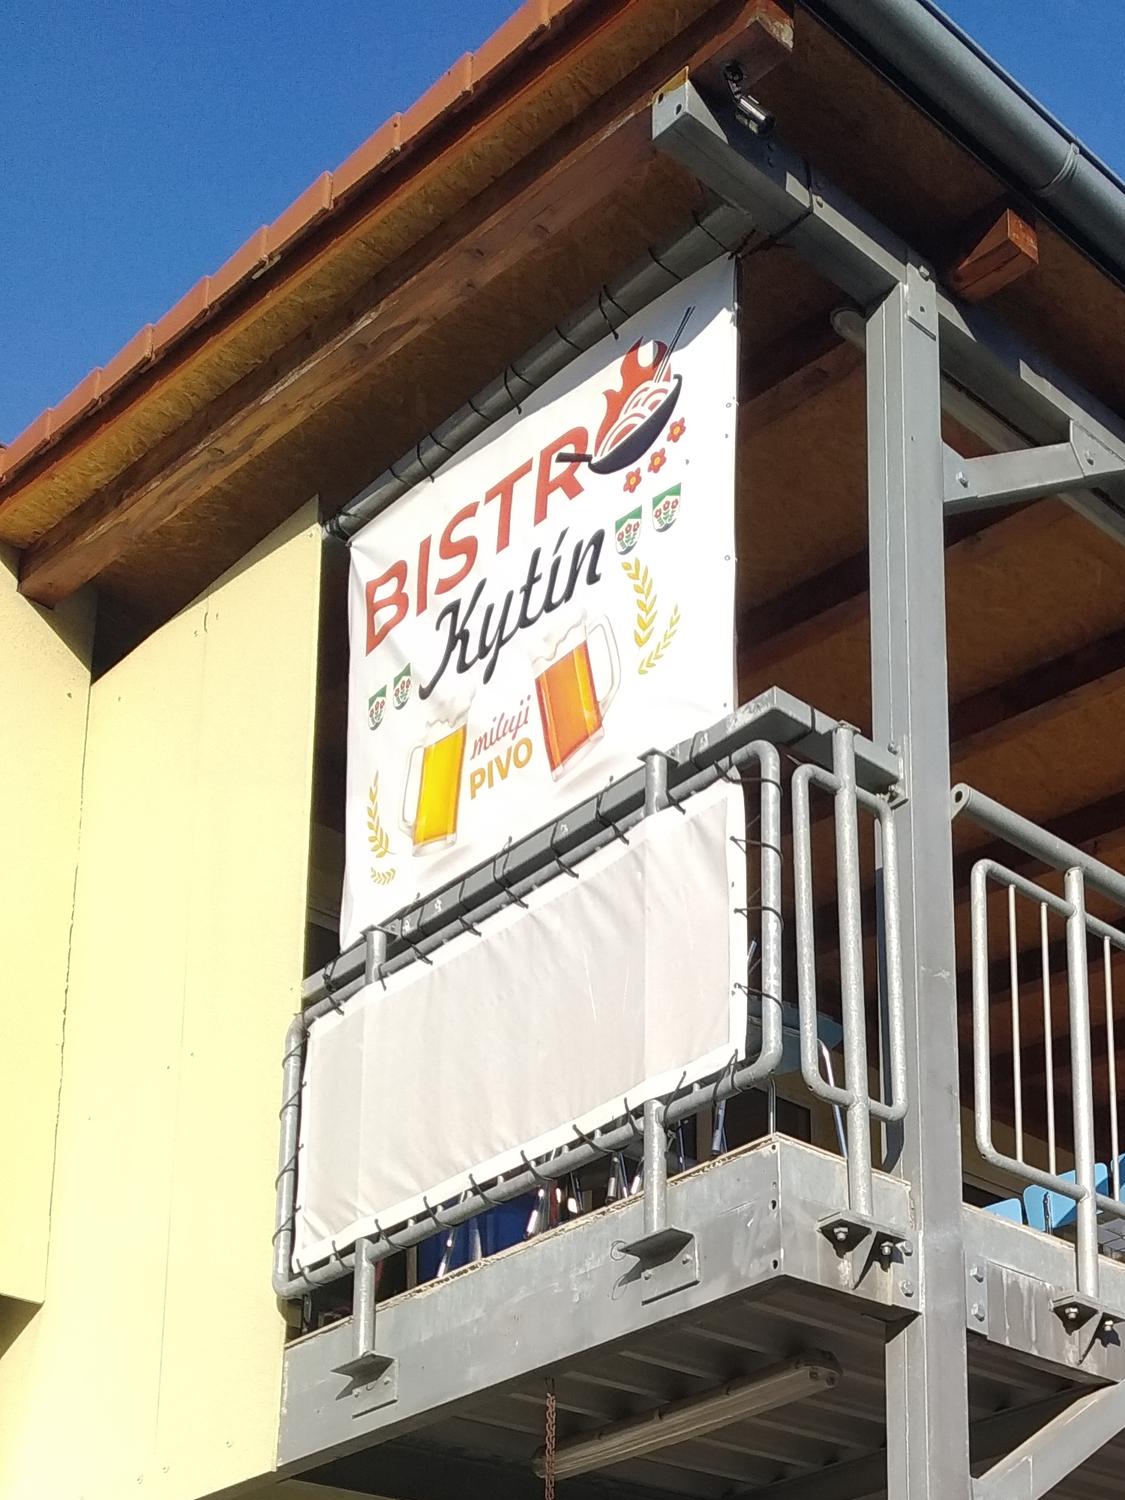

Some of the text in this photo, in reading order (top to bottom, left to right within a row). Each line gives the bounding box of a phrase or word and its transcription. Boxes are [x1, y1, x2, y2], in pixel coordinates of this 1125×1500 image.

[419, 527, 605, 701] Kytín
[470, 695, 532, 761] miluji
[470, 734, 533, 800] PIVO
